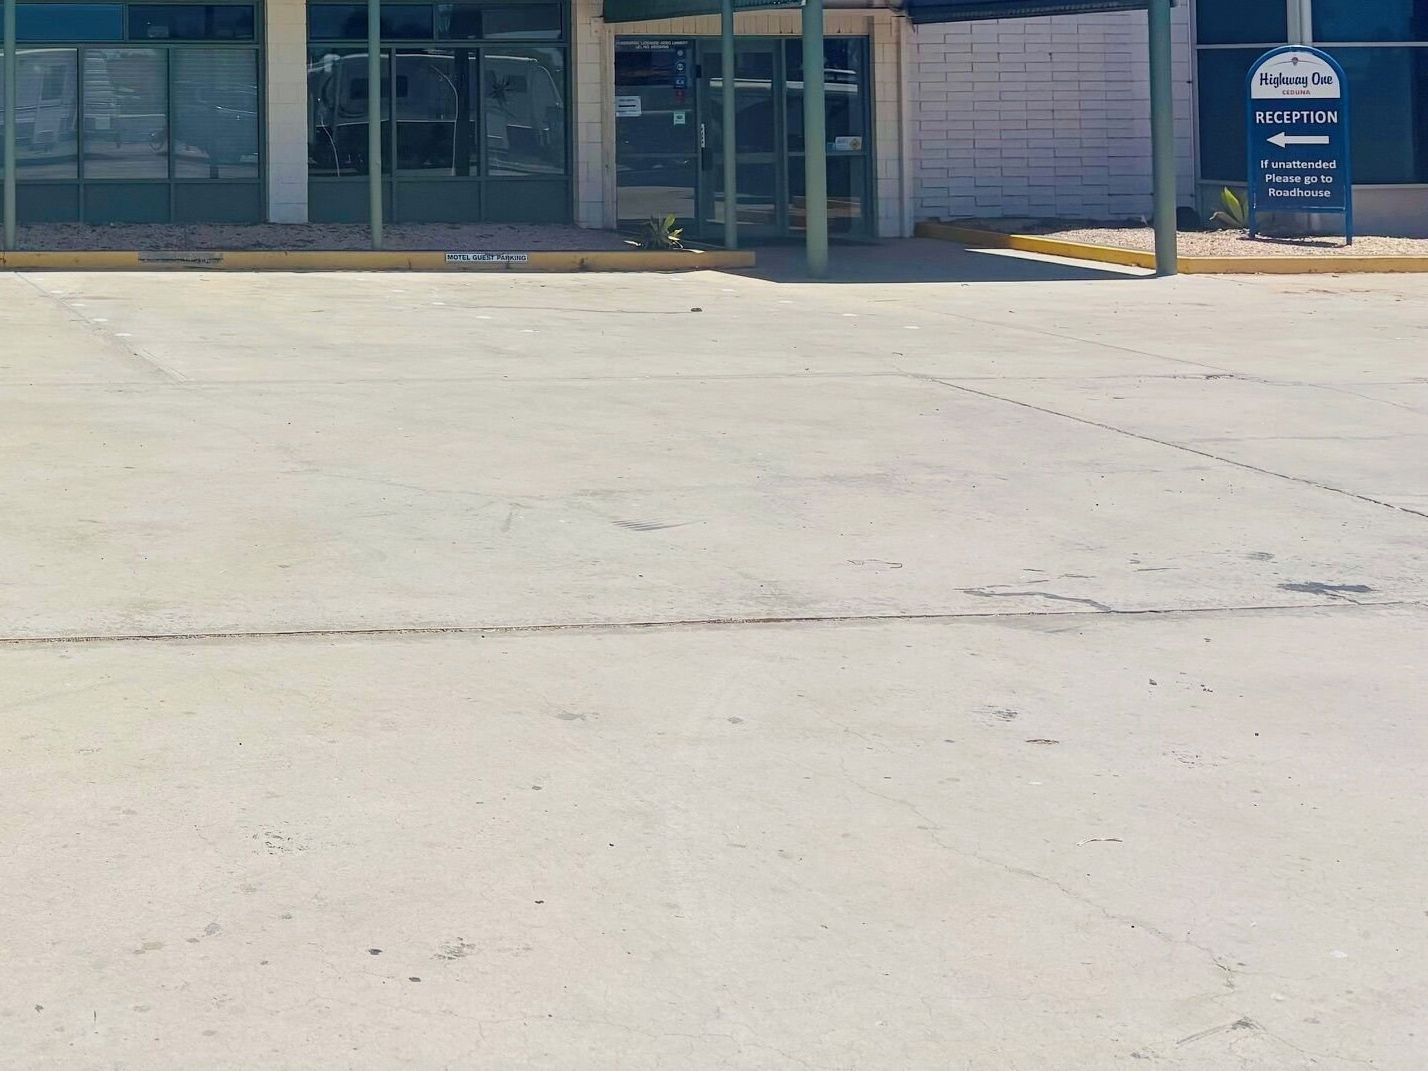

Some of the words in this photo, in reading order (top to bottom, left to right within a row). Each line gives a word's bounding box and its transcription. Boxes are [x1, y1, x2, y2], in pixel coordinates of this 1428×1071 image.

[1259, 72, 1309, 89] Highway
[1311, 71, 1334, 86] One
[1255, 111, 1338, 124] RECEPTION
[1260, 160, 1269, 169] If
[1271, 160, 1337, 169] unattended
[1265, 174, 1301, 183] Please
[1304, 176, 1318, 185] go
[1320, 175, 1333, 183] to
[1268, 188, 1331, 197] Roadhouse
